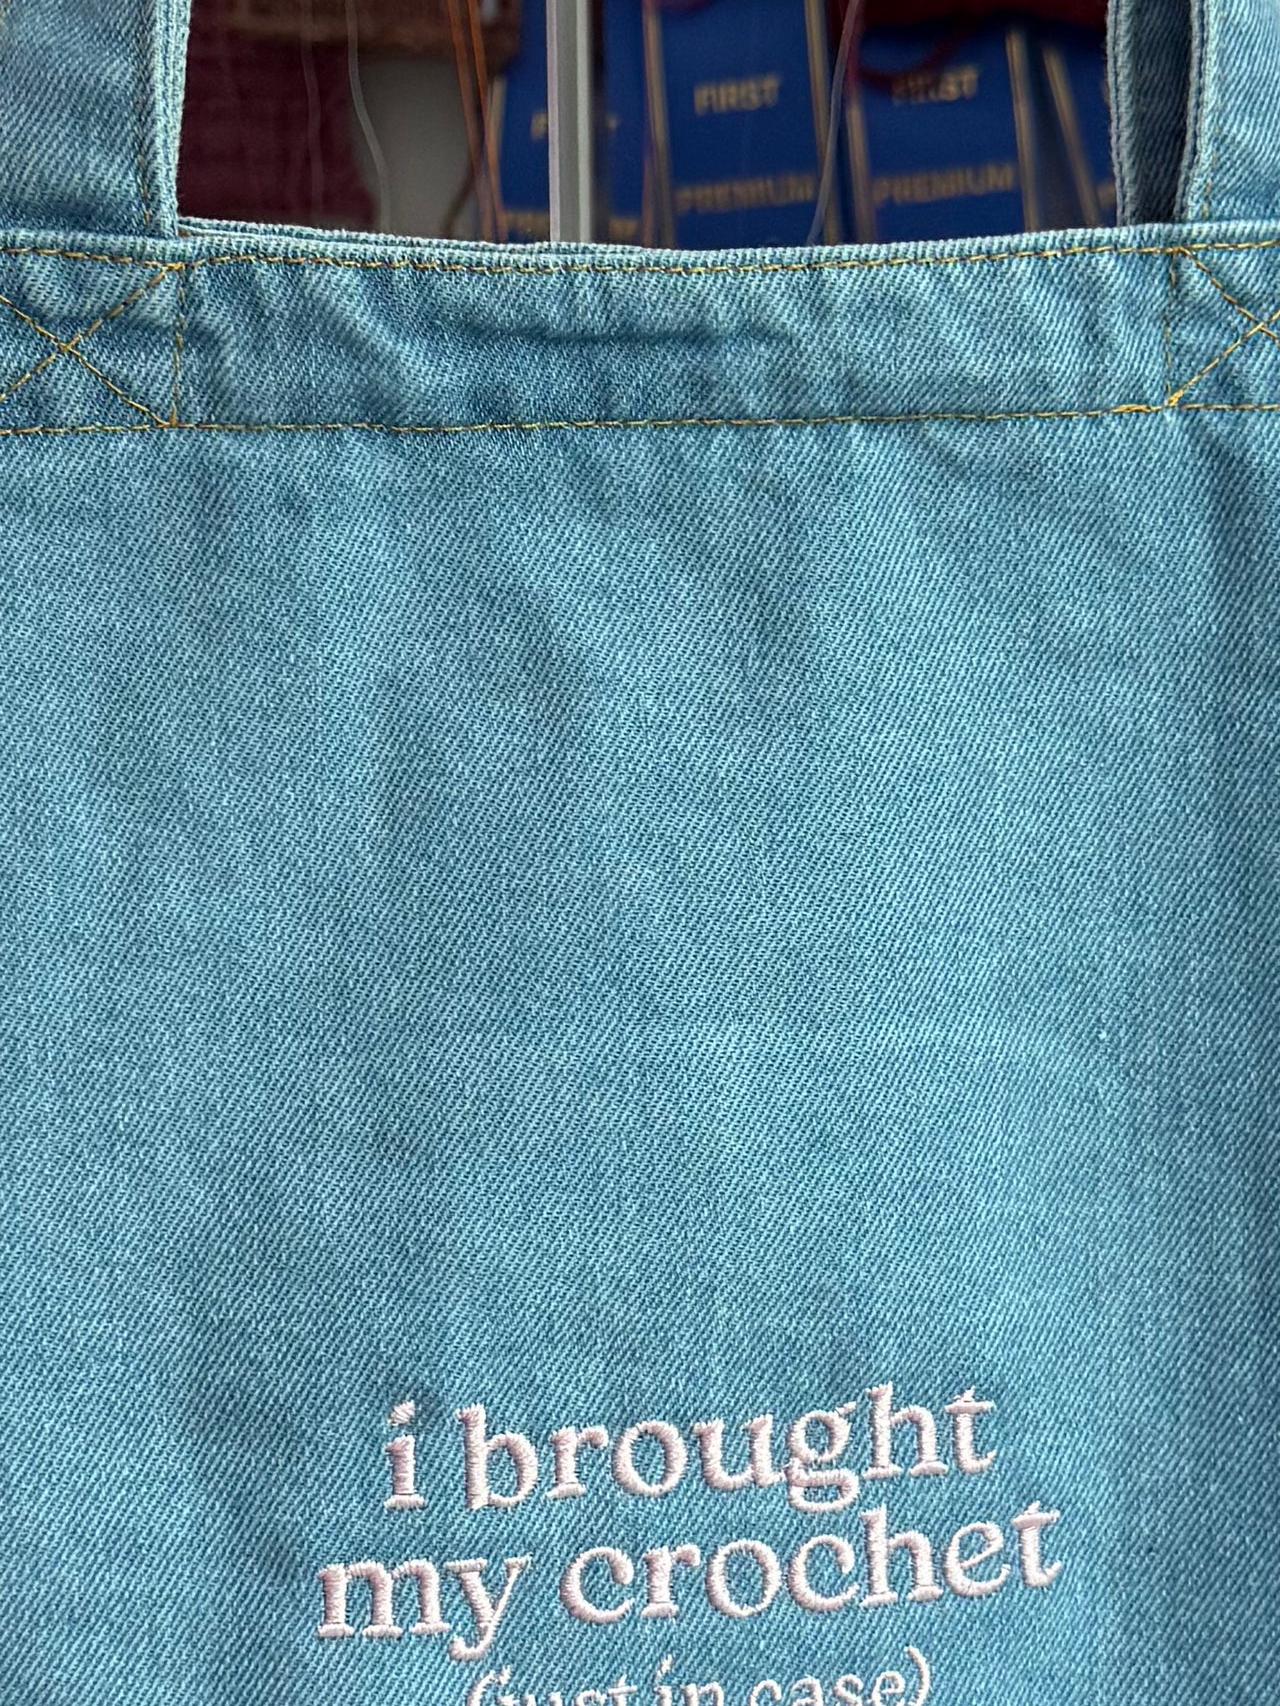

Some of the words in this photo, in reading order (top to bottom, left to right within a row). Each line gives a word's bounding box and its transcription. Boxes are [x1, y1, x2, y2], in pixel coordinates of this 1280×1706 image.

[383, 1400, 425, 1510] i
[455, 1381, 998, 1513] brought
[318, 1555, 531, 1661] my
[559, 1499, 1064, 1625] crochet
